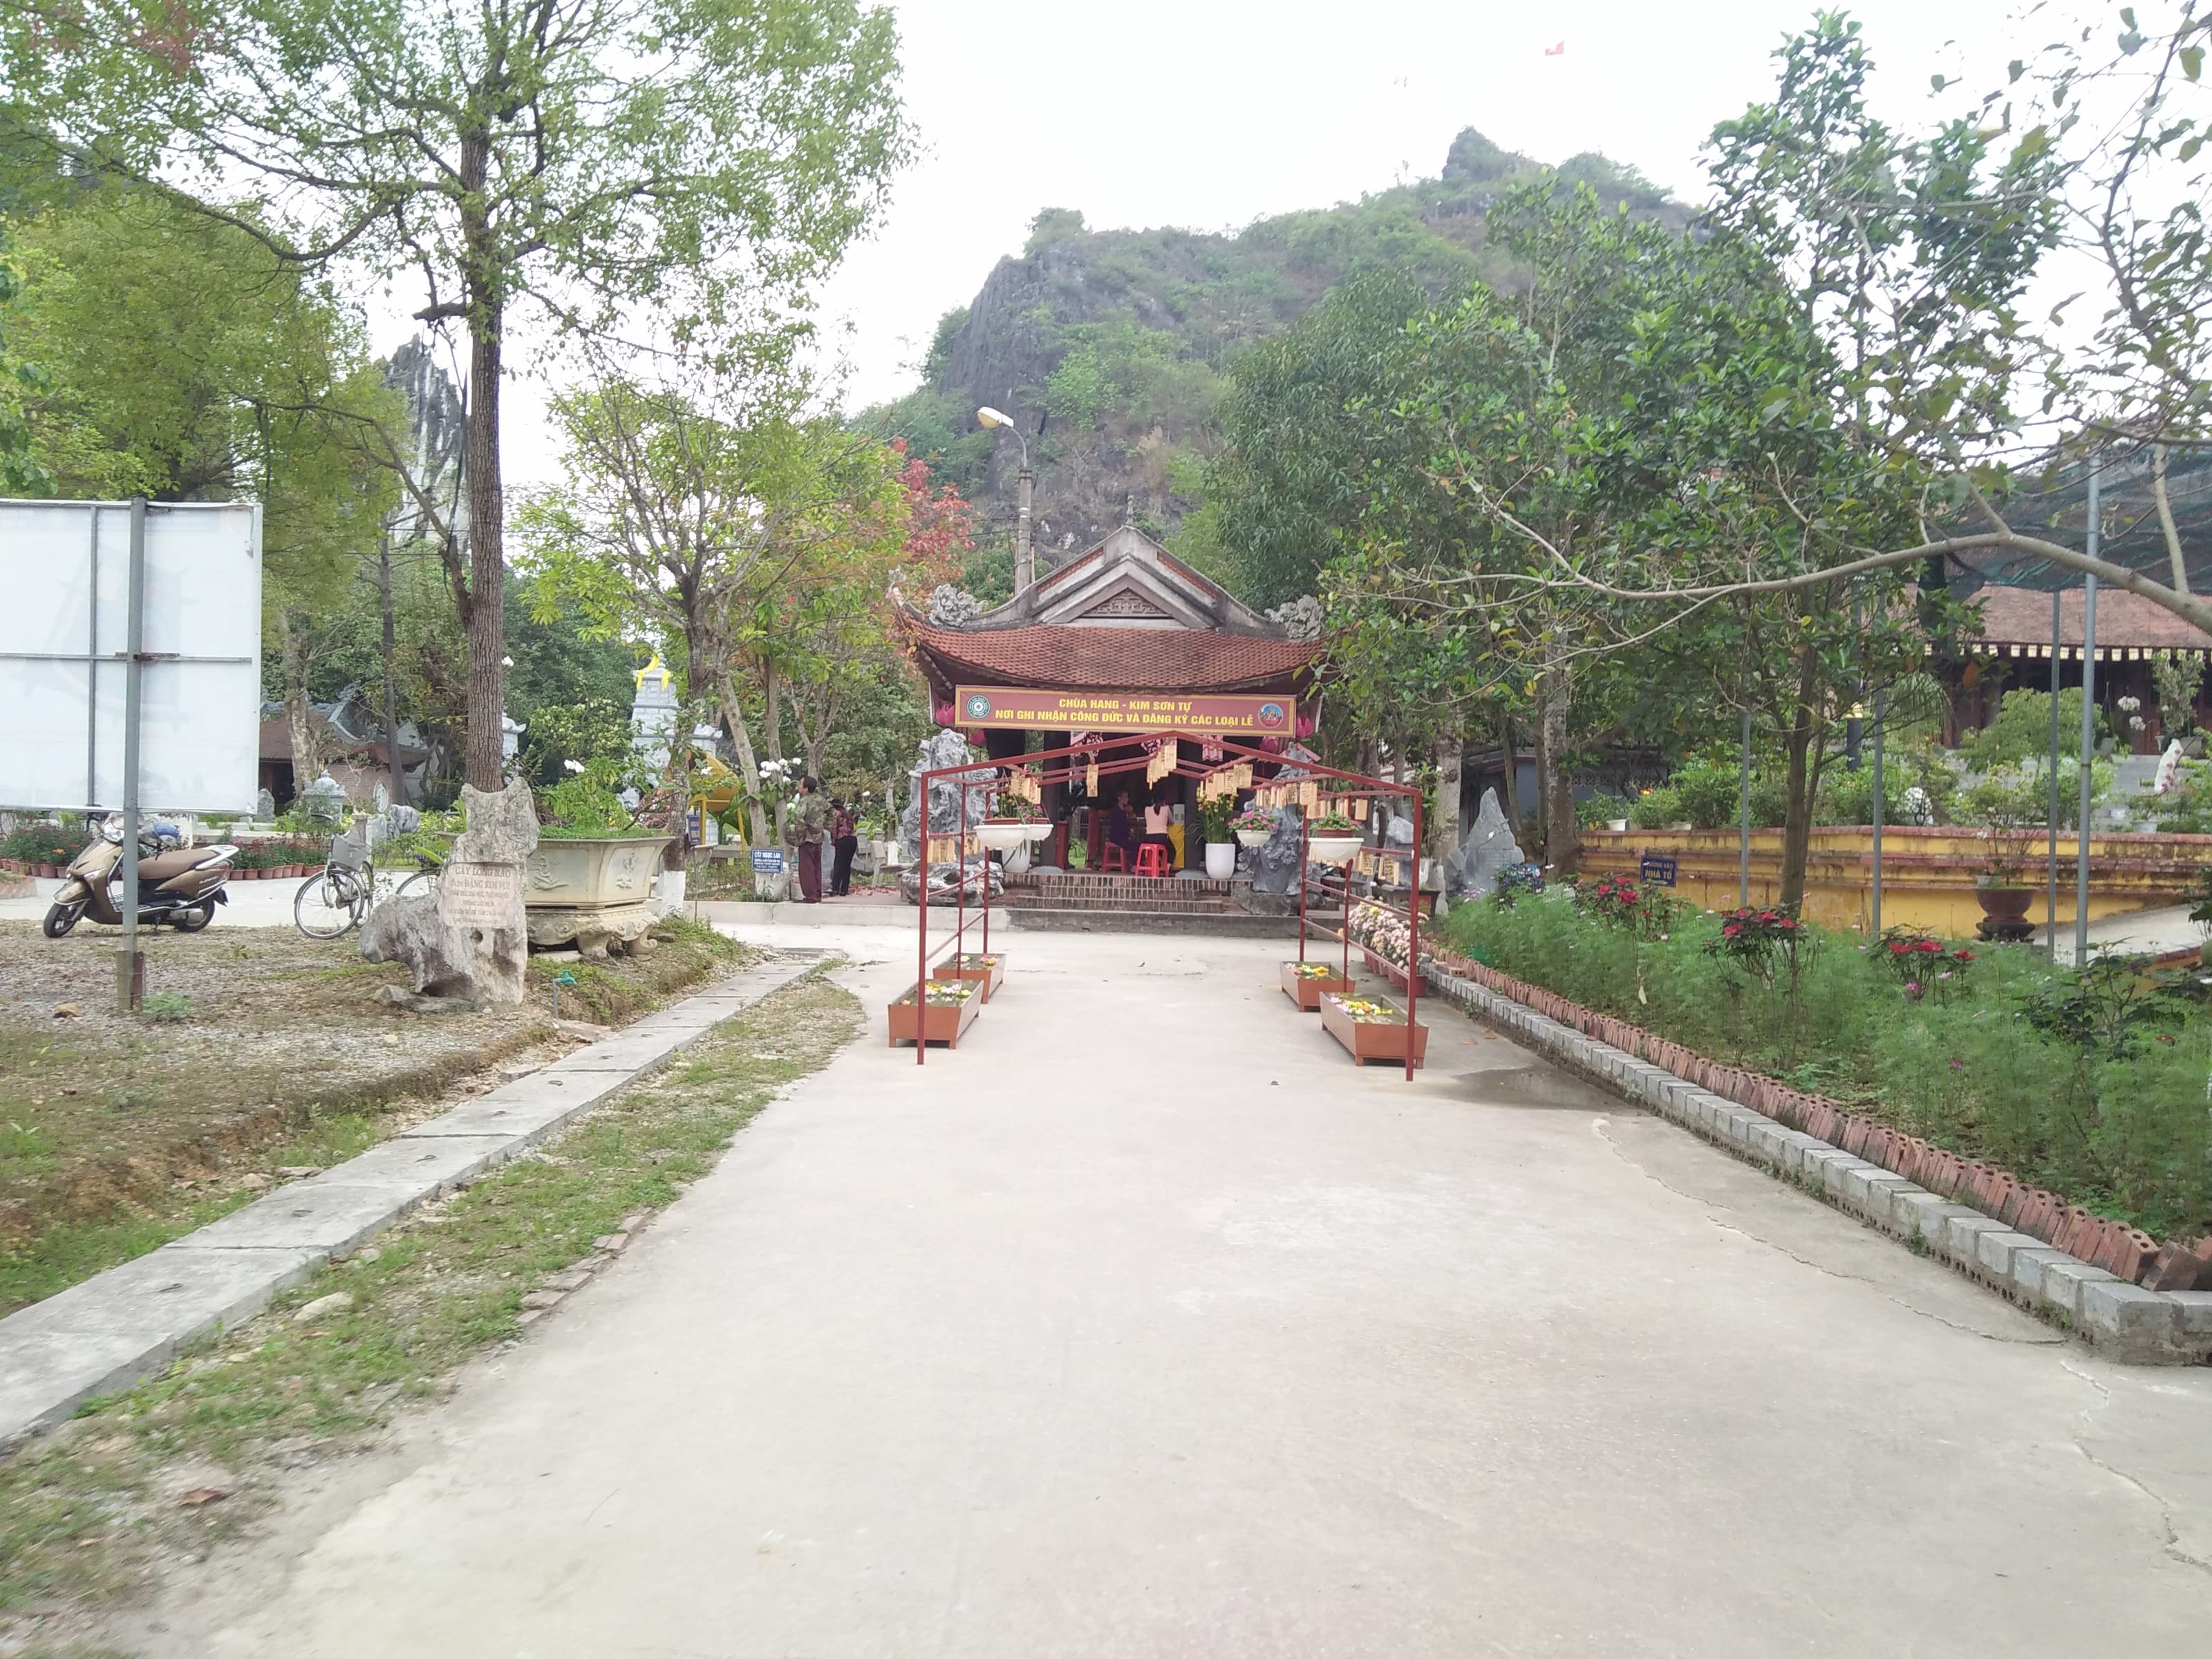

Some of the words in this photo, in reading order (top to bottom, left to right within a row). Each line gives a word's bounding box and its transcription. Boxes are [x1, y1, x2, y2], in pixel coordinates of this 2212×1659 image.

[1058, 697, 1087, 709] CHÙA
[1090, 700, 1119, 709] HANG
[1129, 700, 1150, 710] KIM
[1153, 701, 1174, 711] SƠN
[1178, 701, 1192, 713] TỰ
[995, 709, 1014, 719] NƠI
[1017, 710, 1035, 720] GHI
[1038, 710, 1067, 722] NHẬN
[1070, 711, 1099, 722] CÔNG
[1102, 711, 1123, 722] ĐỨC
[1126, 712, 1140, 723] VÀ
[1142, 713, 1172, 724] ĐĂNG
[1174, 713, 1188, 724] KÝ
[1191, 713, 1212, 725] CÁC
[1215, 715, 1238, 727] LOẠI
[1241, 714, 1255, 726] LỄ
